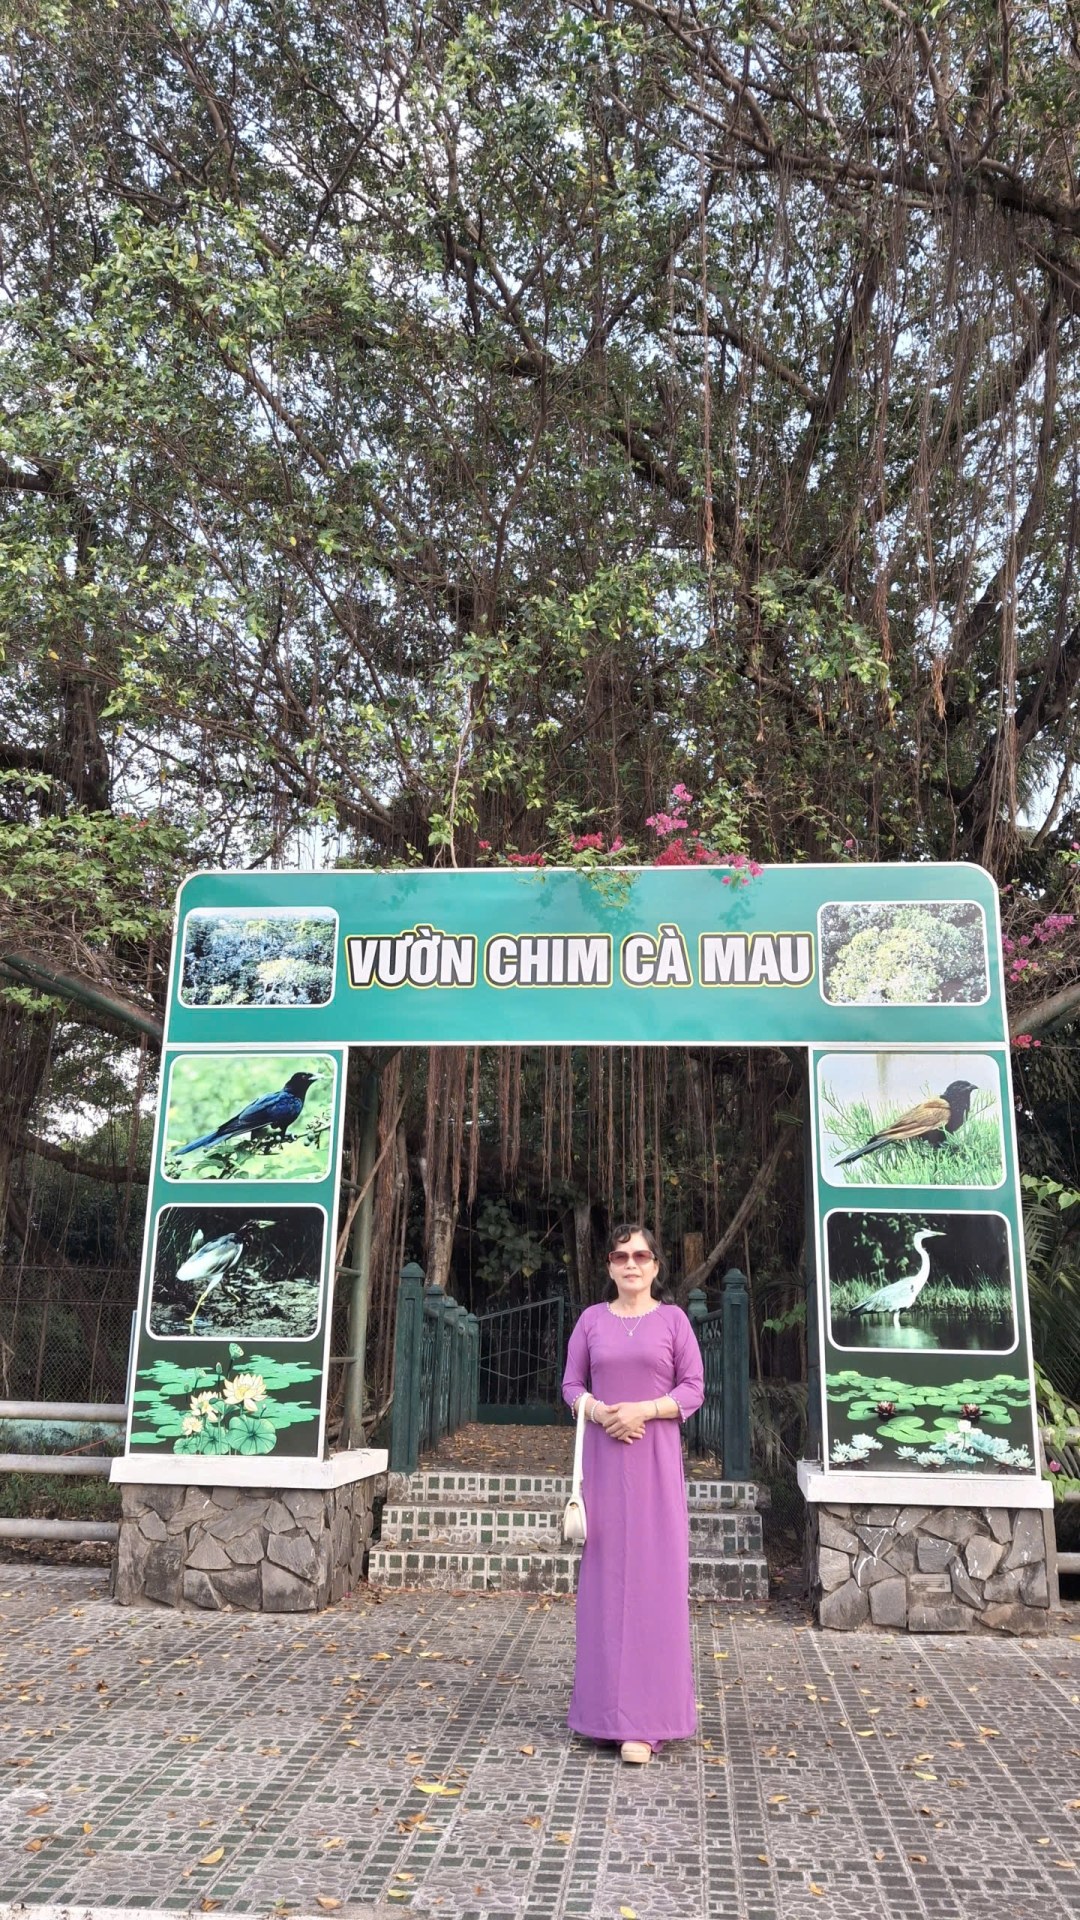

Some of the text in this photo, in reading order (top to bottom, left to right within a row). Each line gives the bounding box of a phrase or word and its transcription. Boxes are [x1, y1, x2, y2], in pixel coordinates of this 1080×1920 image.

[347, 926, 812, 986] VƯỜN CHIM CÀ MAU
